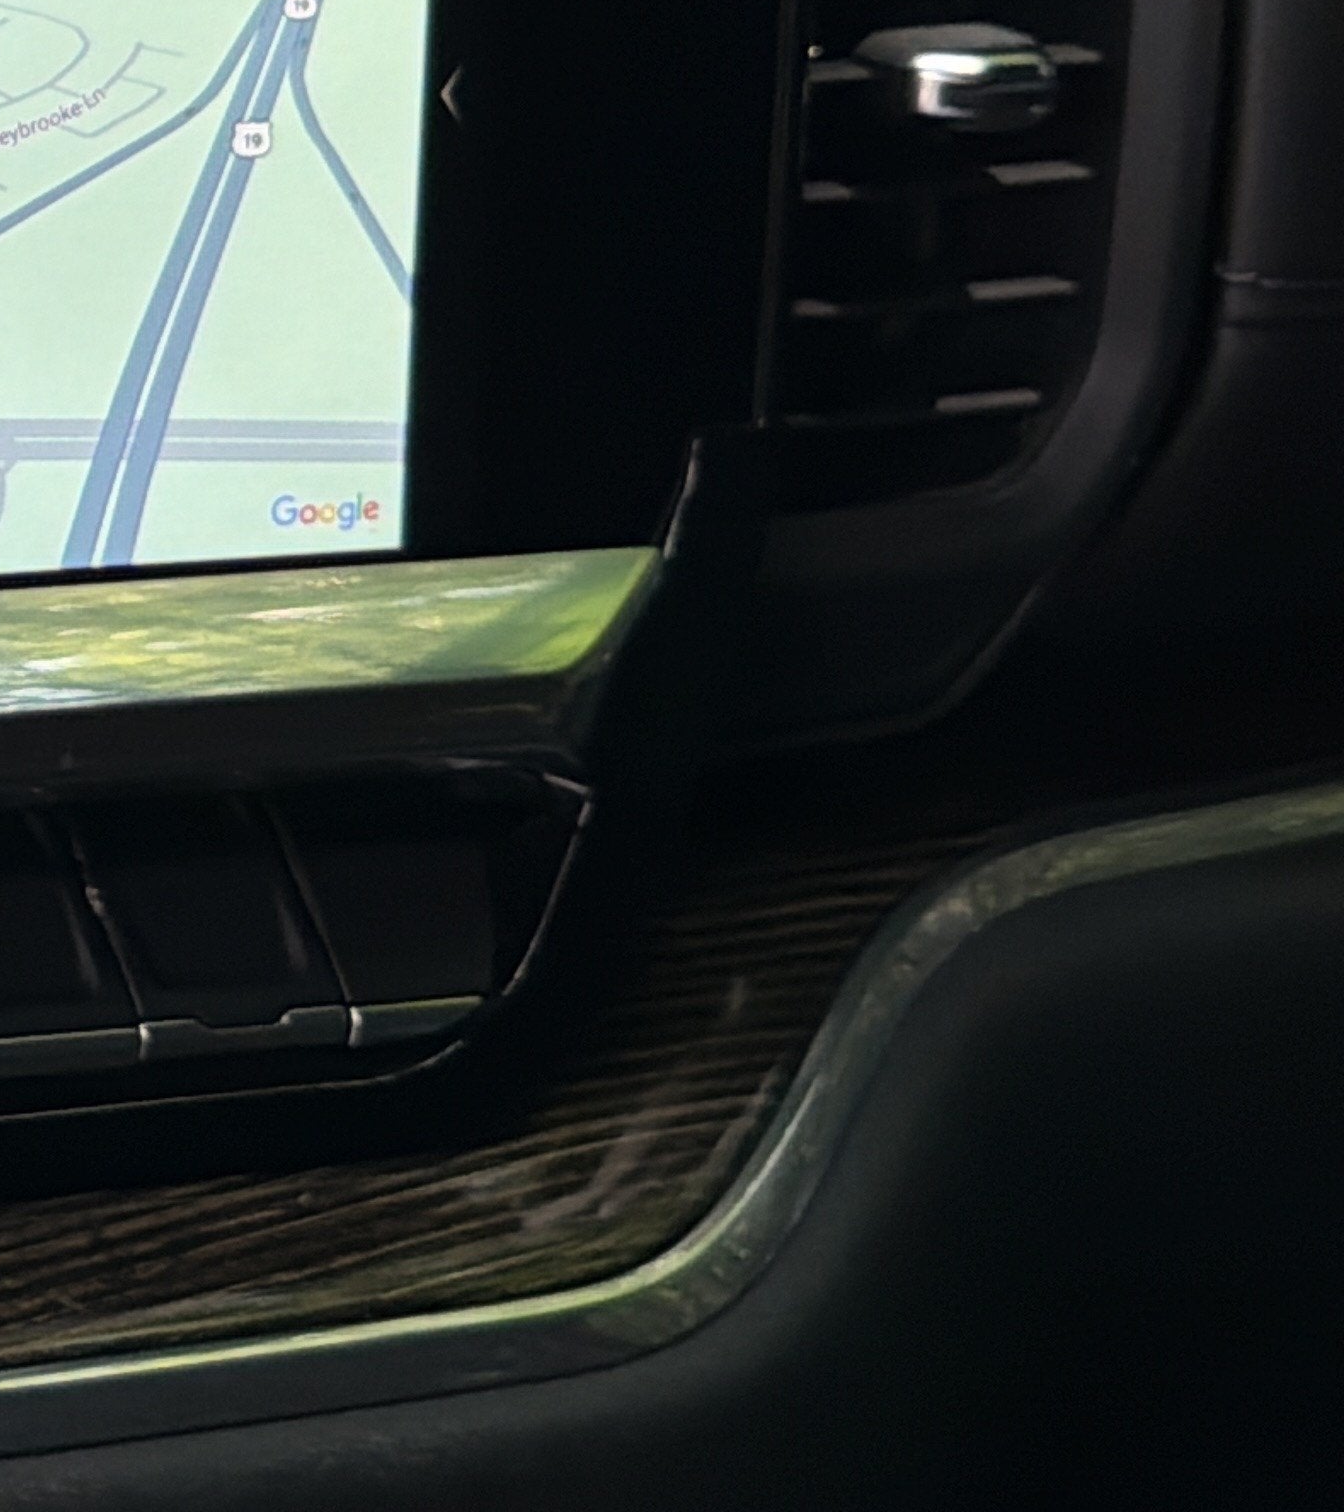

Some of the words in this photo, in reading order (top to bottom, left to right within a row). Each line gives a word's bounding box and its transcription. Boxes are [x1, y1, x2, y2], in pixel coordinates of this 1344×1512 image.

[81, 87, 107, 113] Ln
[243, 133, 263, 148] 19
[270, 492, 381, 531] Google
